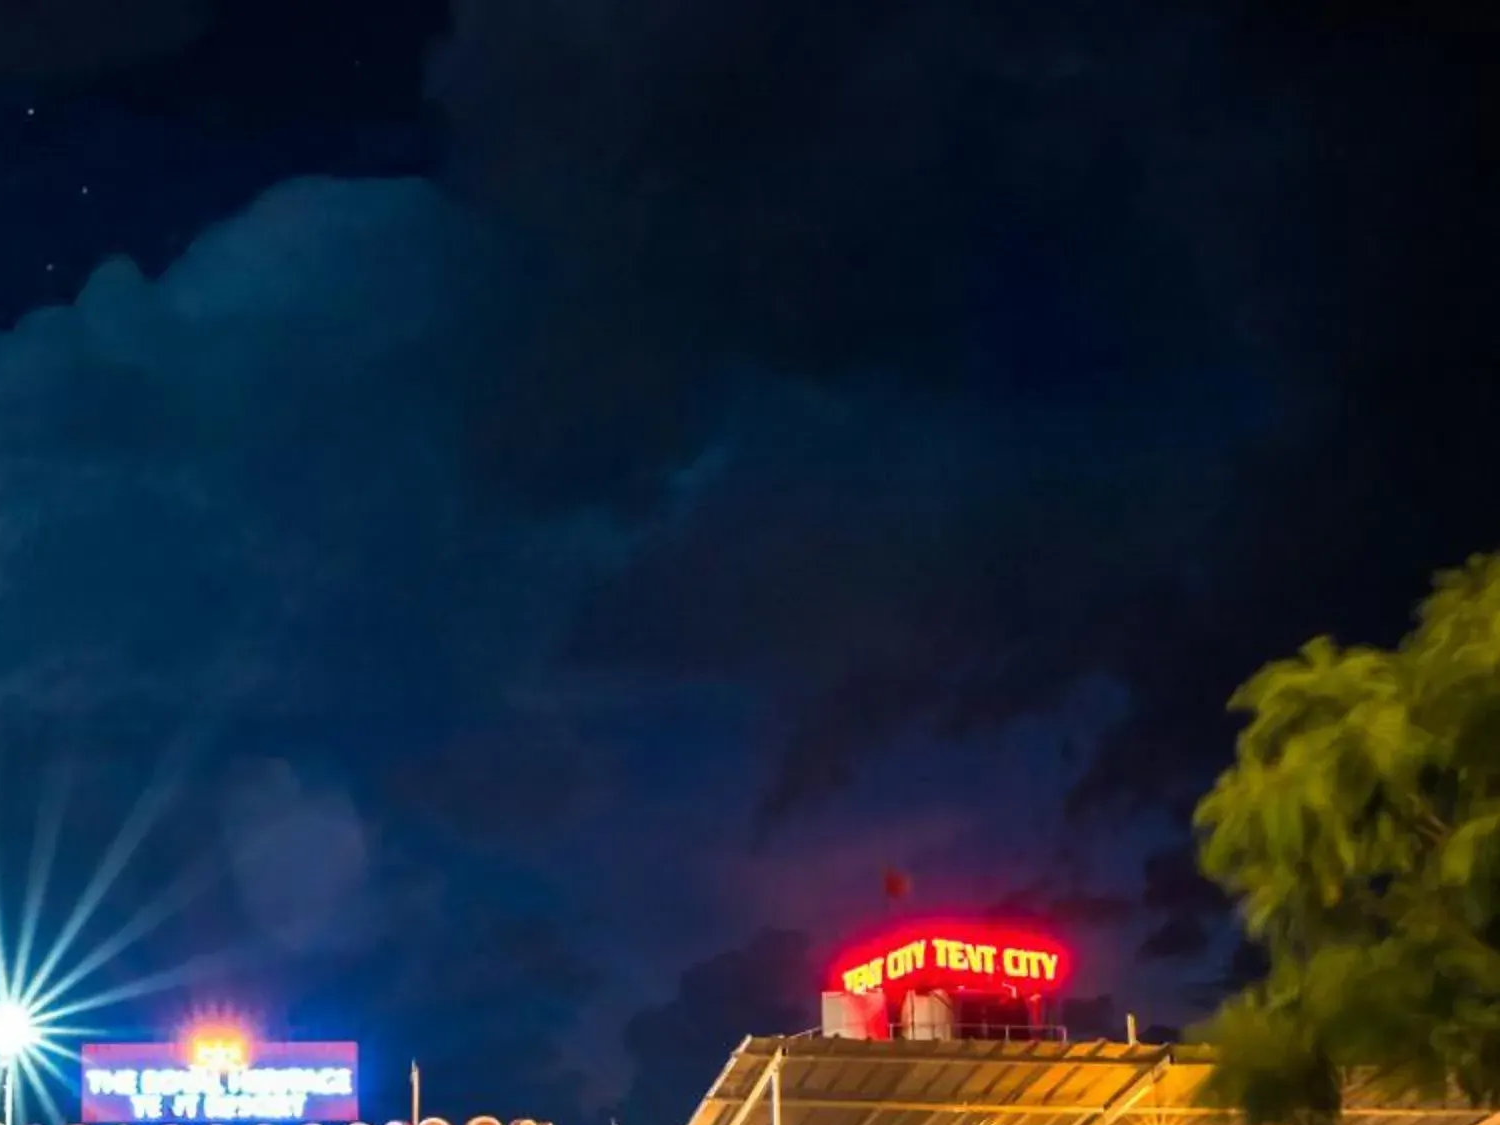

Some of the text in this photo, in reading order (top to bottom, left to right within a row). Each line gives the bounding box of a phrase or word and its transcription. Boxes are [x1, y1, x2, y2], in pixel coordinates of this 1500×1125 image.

[887, 940, 927, 980] CITY
[932, 938, 1058, 980] TENT CITY
